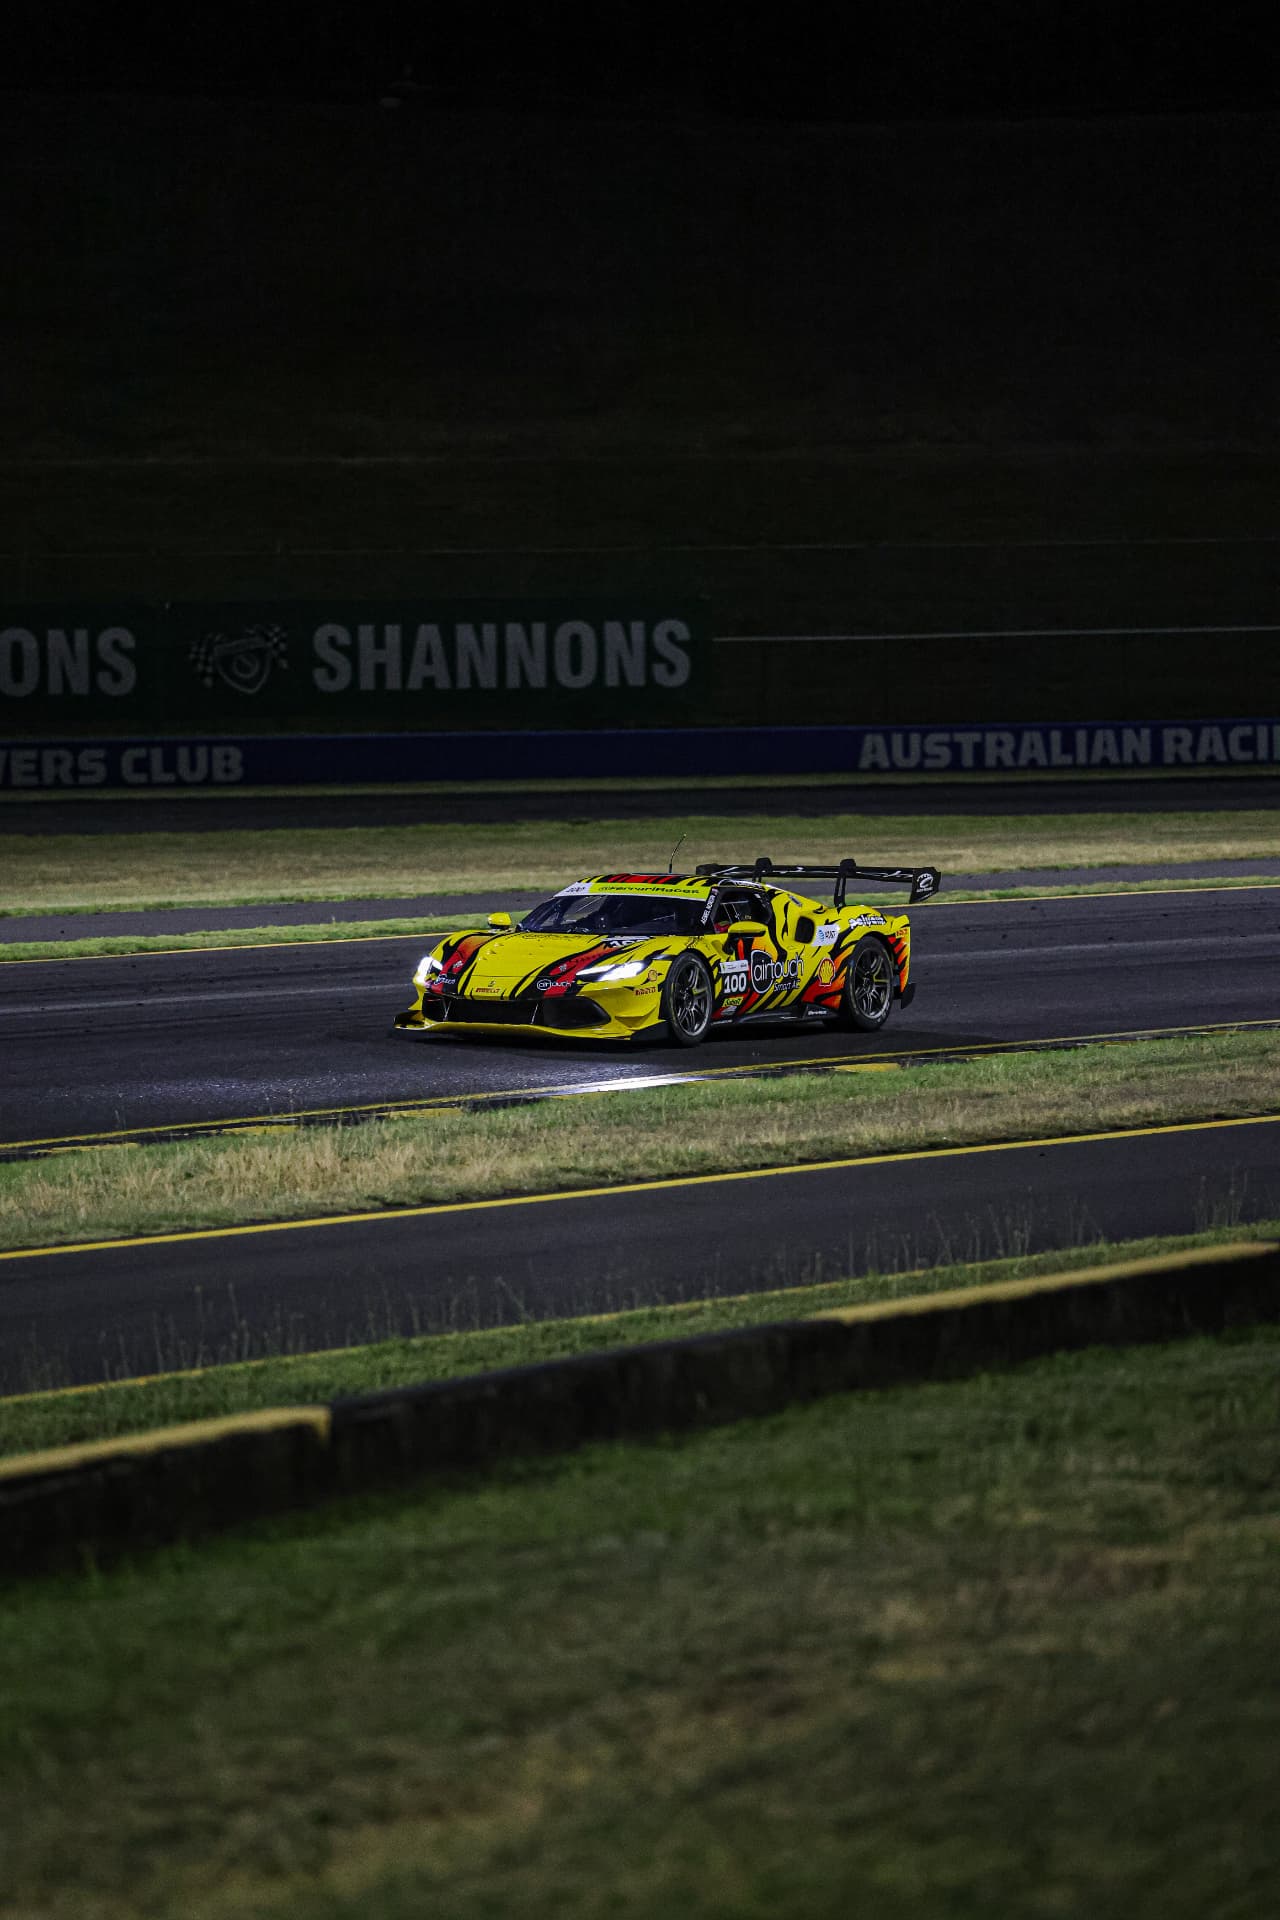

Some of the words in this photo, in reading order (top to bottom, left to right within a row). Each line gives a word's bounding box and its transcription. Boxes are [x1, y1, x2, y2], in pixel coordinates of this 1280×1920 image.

[0, 626, 137, 697] ONS
[312, 619, 692, 694] SHANNONS
[120, 745, 244, 785] CLUB
[857, 727, 1151, 770] AUSTRALIAN
[723, 973, 747, 994] 100
